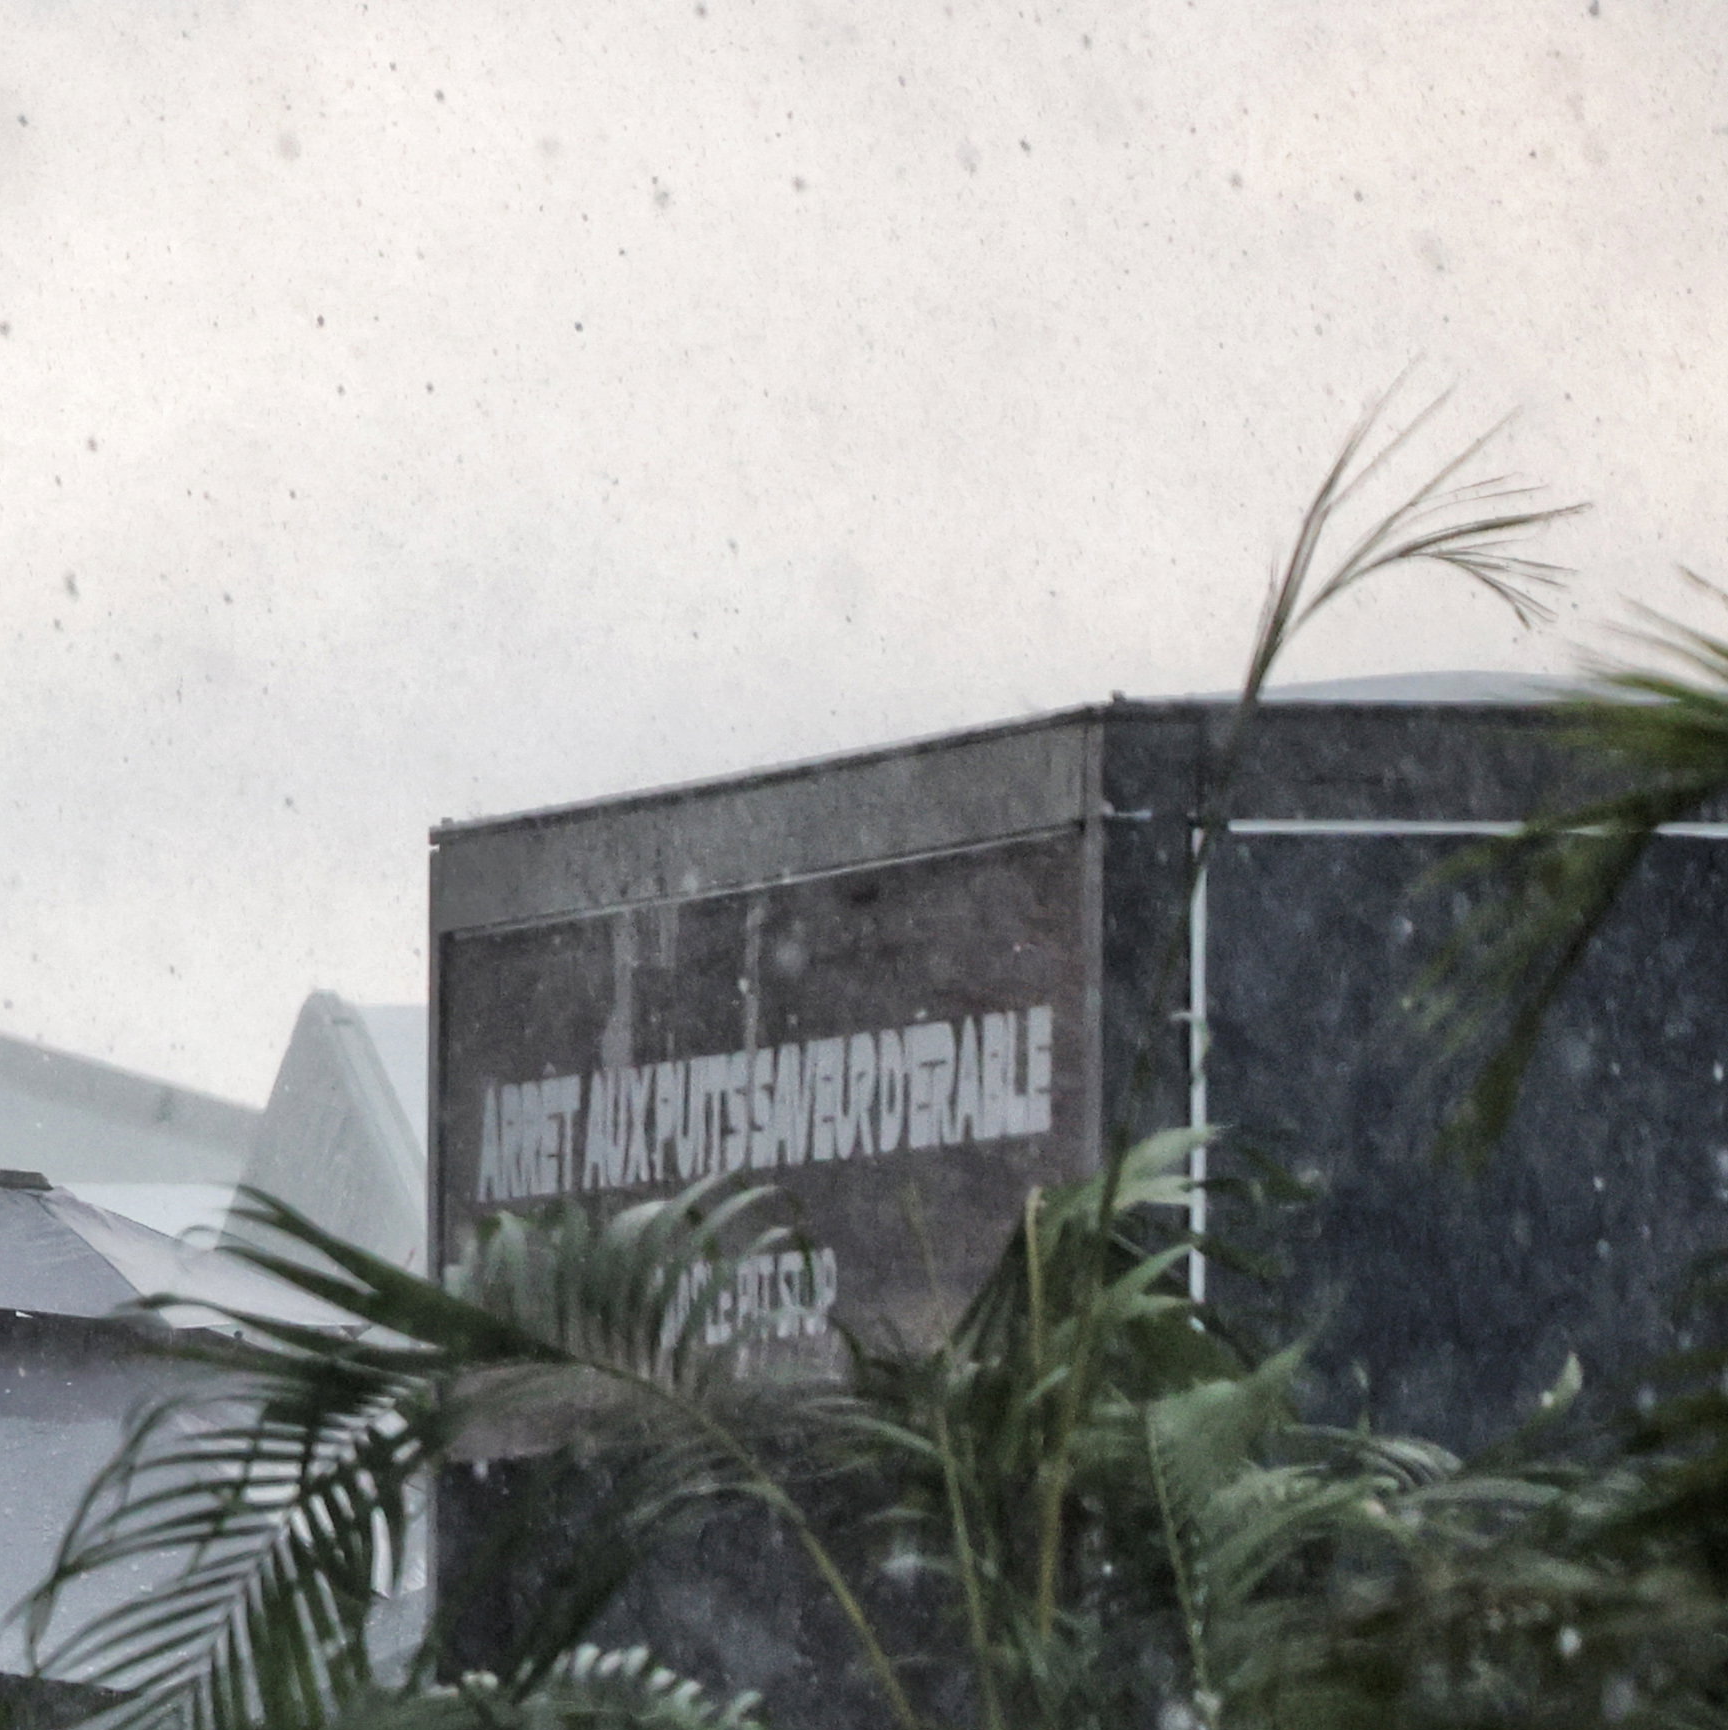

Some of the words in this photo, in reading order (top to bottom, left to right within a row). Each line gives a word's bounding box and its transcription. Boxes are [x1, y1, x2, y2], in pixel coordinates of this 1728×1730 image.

[582, 1064, 651, 1190] AUX
[653, 1051, 749, 1181] PUITS
[749, 1030, 874, 1170] SAVEUR
